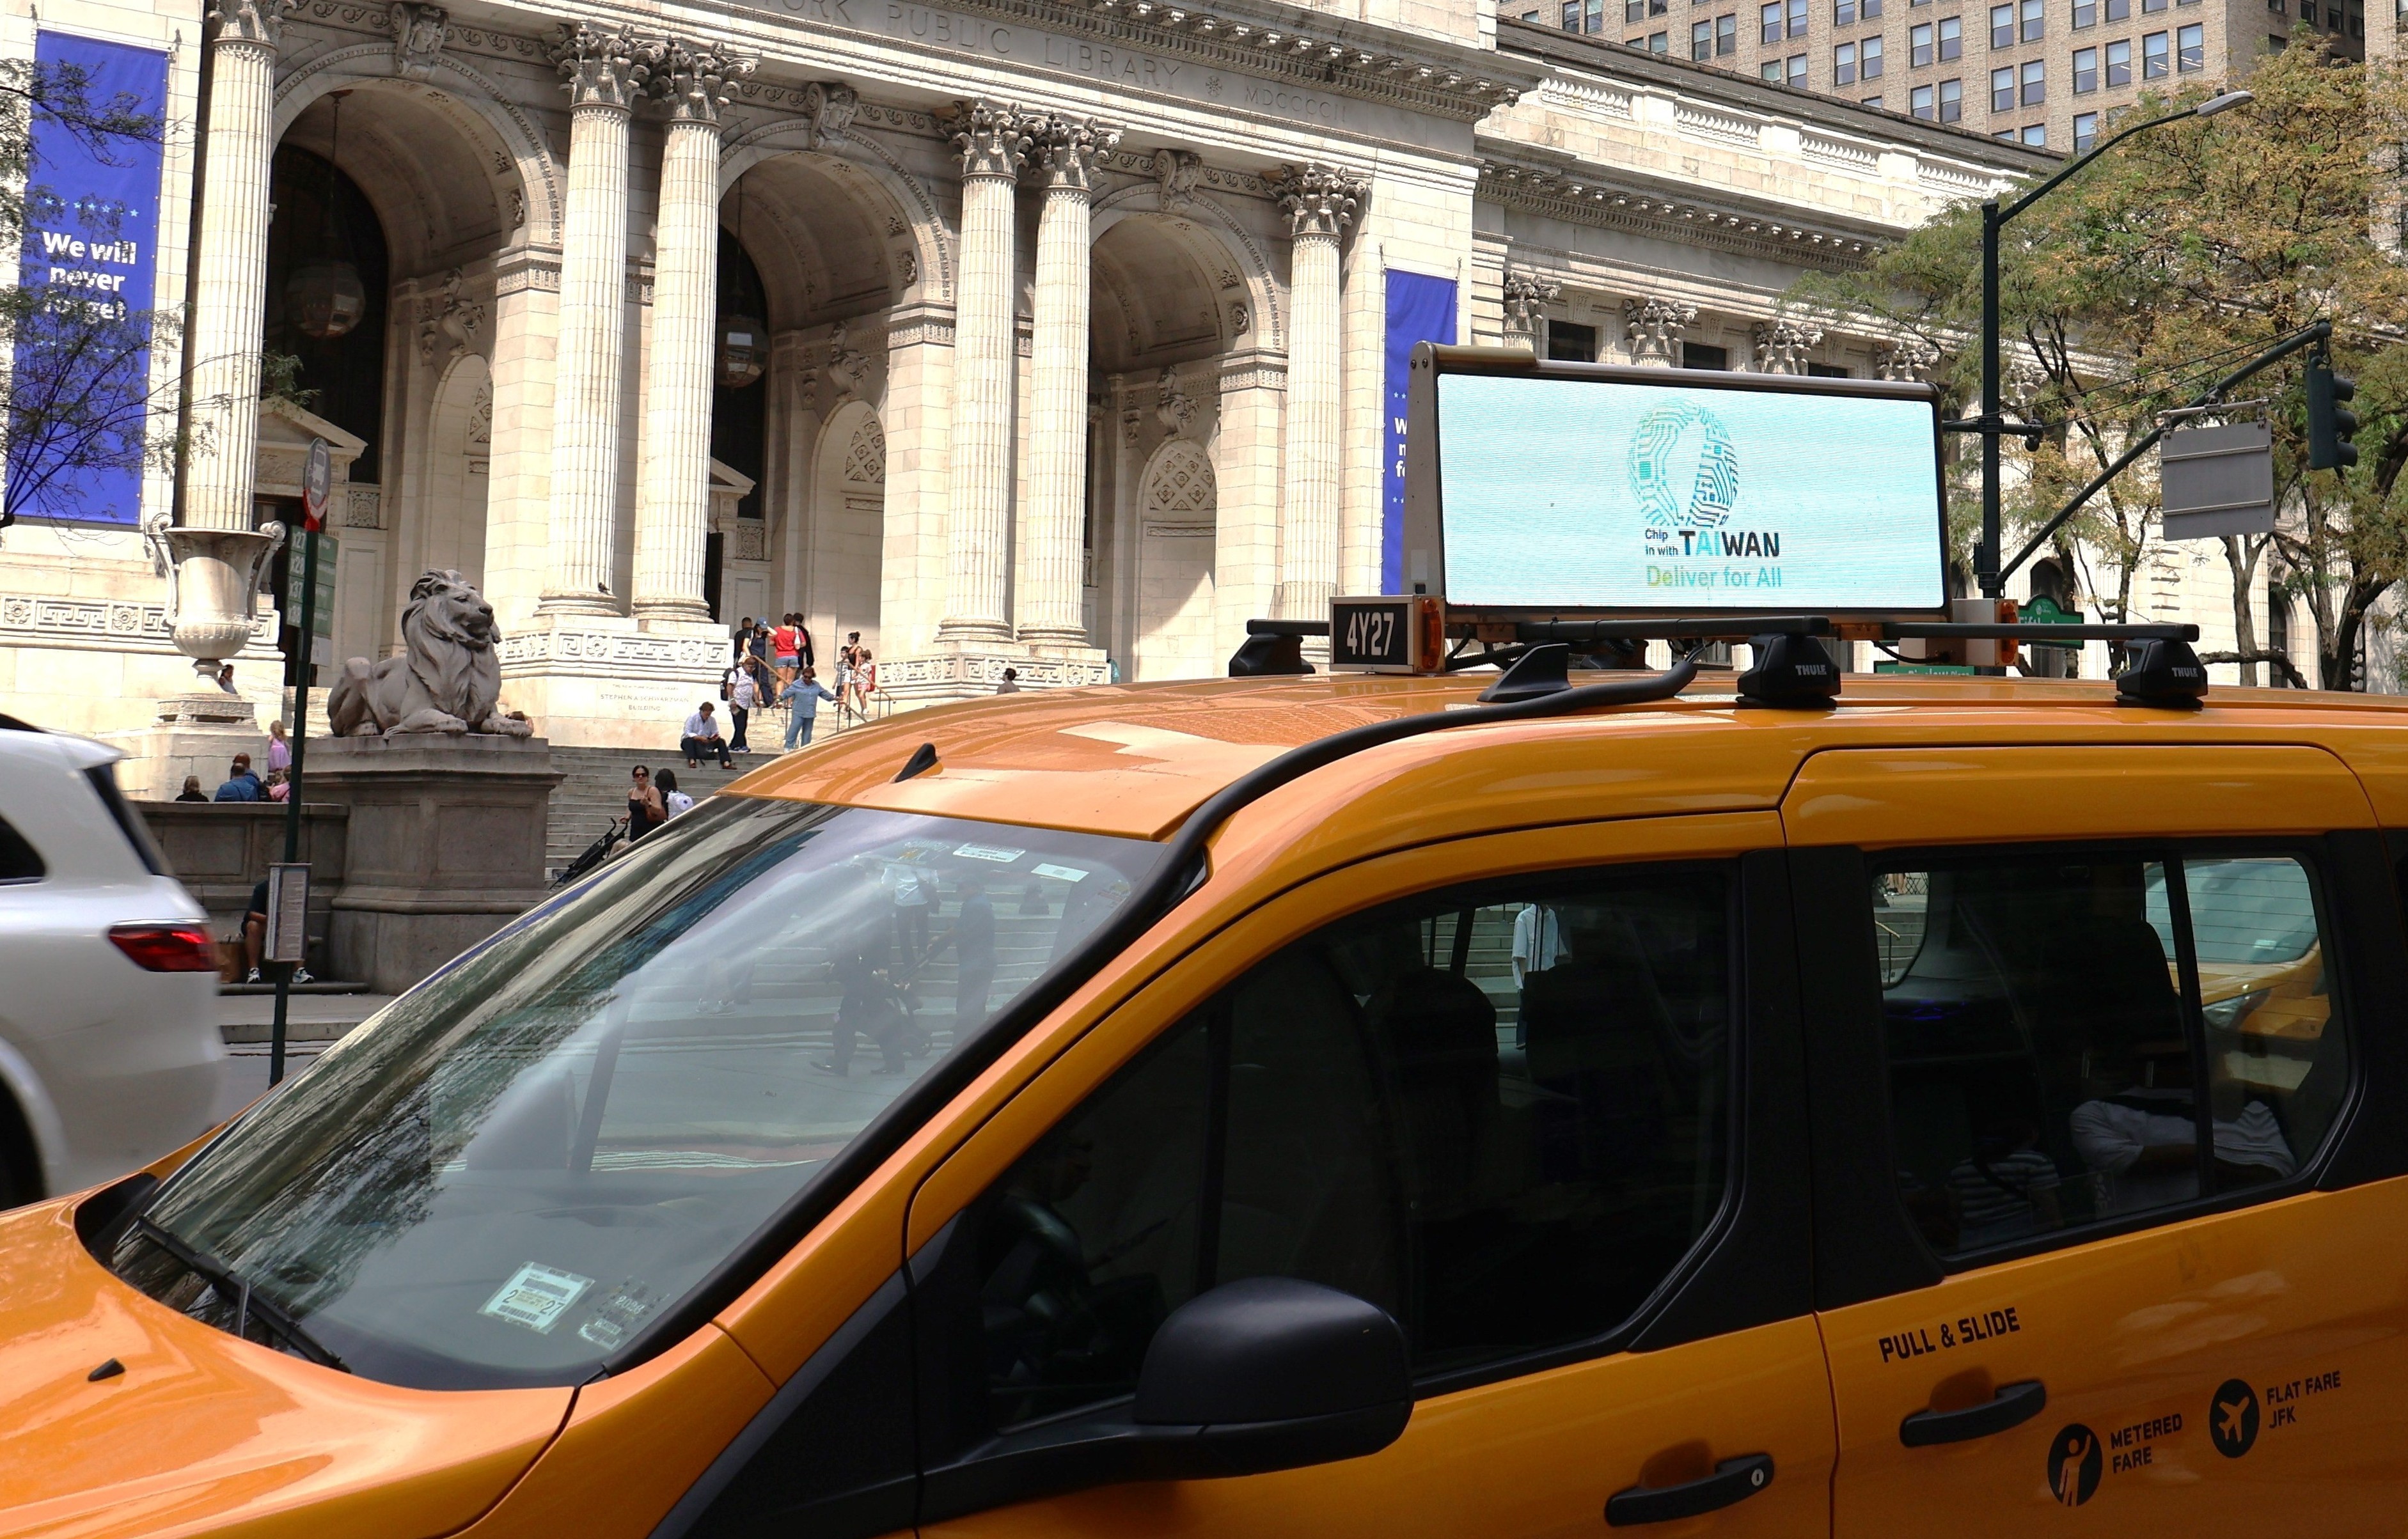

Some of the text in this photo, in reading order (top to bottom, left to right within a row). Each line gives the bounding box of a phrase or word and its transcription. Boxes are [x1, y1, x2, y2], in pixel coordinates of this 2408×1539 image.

[763, 0, 1346, 122] RK PUBLIC LIBRARY MDCCCCII
[43, 231, 136, 265] We will
[50, 267, 125, 292] never
[1645, 528, 1668, 543] Chip
[1645, 531, 1779, 557] in with TAIWAN
[1647, 565, 1781, 587] Deliver for All
[1347, 612, 1394, 656] 4Y27
[1795, 664, 1827, 675] THULE
[2171, 667, 2198, 677] THULE
[540, 1300, 565, 1316] 27
[1878, 1307, 2021, 1363] PULL & SLIDE
[2266, 1370, 2341, 1405] FLAT FARE
[2111, 1413, 2184, 1449] METERED
[2268, 1407, 2297, 1430] JFK
[2113, 1446, 2153, 1474] FARE
